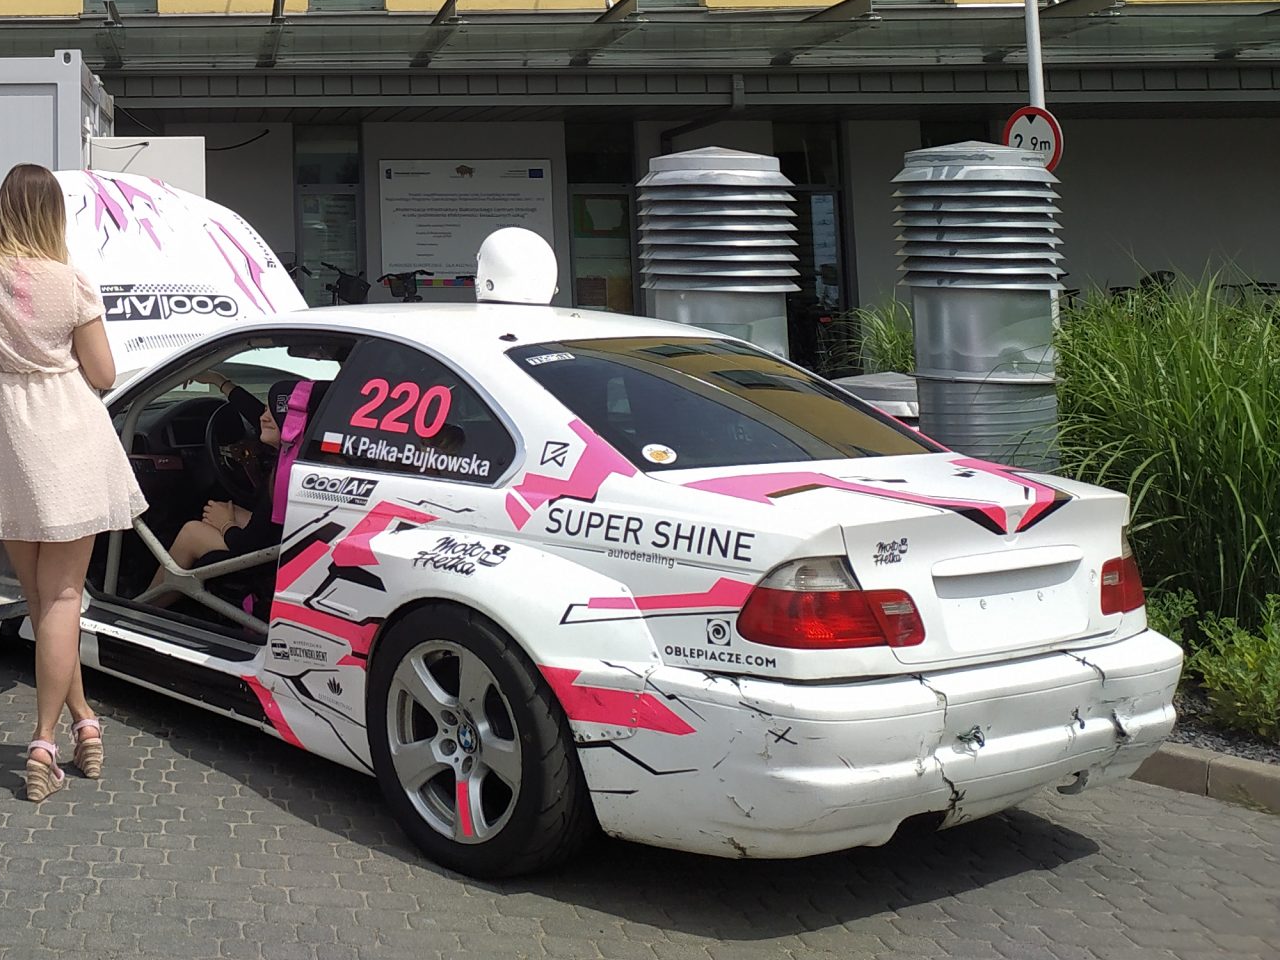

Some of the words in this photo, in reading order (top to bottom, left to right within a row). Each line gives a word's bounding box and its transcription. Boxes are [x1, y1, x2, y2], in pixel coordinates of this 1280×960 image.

[350, 378, 452, 438] 220
[342, 434, 355, 455] K
[357, 436, 490, 476] Pałka-Bujkowska
[431, 536, 486, 558] Moto
[545, 507, 644, 545] SUPER
[650, 520, 756, 563] SHINE
[607, 548, 676, 569] autodetailing
[664, 645, 777, 668] OBLEPIACZE.COM
